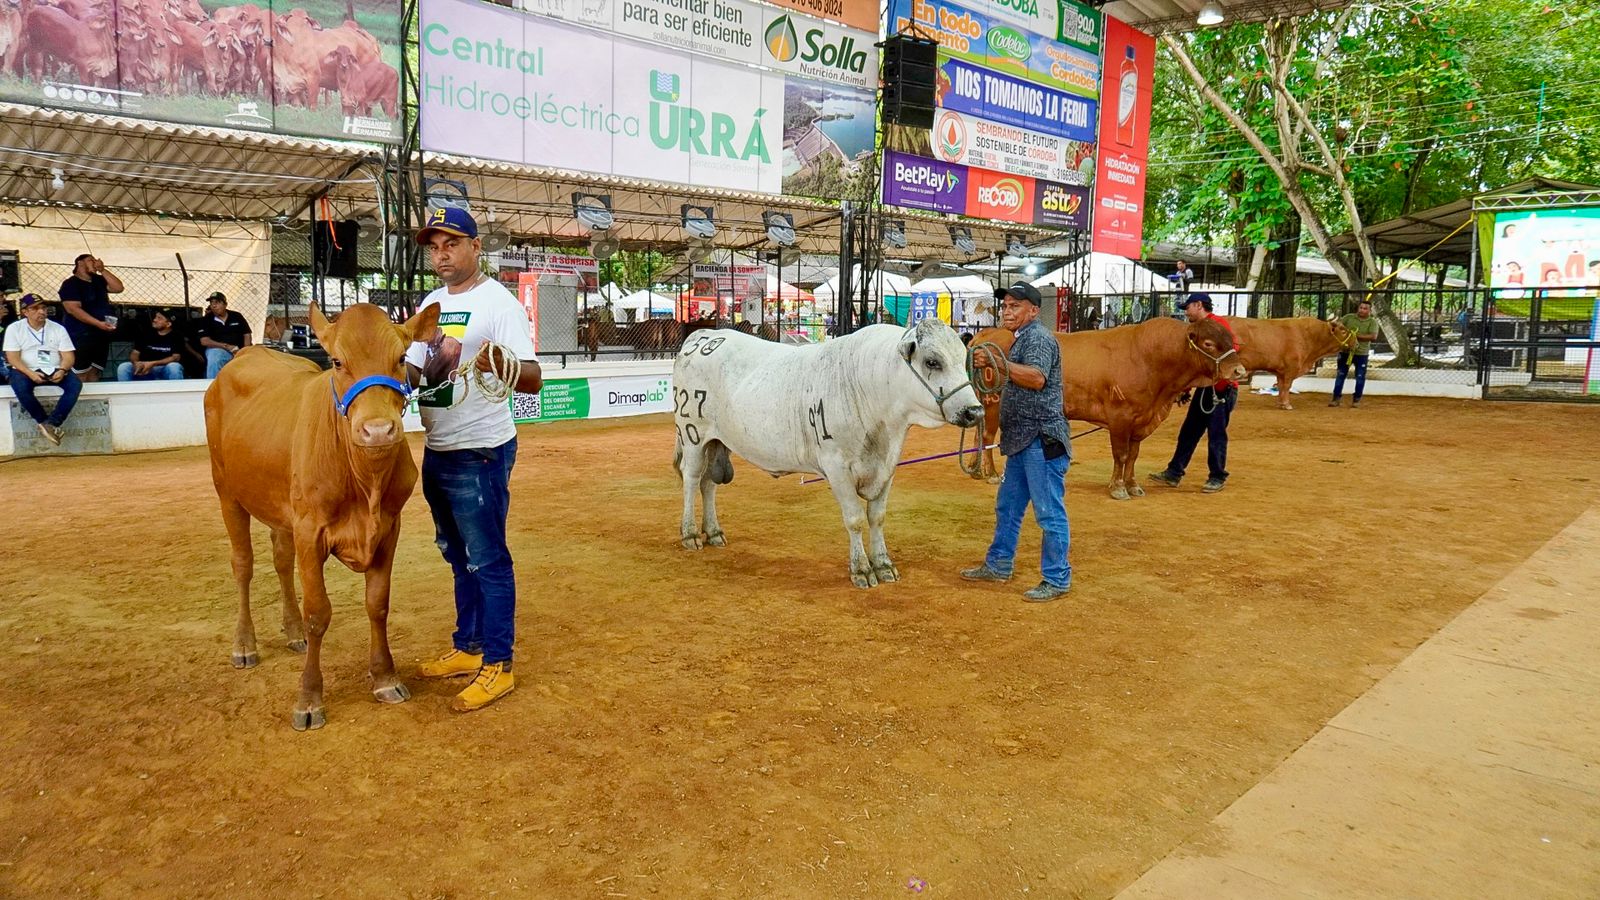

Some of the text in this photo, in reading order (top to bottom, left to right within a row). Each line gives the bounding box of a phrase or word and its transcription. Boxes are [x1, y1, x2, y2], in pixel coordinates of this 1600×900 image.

[713, 0, 742, 25] bien
[824, 0, 843, 17] 3024
[914, 0, 936, 26] En
[939, 6, 981, 39] todo
[623, 1, 752, 47] para ser eficiente
[423, 22, 544, 76] Central
[800, 28, 868, 74] Solla
[990, 29, 1027, 55] Codelac
[800, 62, 867, 87] Nutrición Animal
[1050, 61, 1097, 91] Cordobés
[425, 72, 641, 138] Hidroeléctrica
[955, 66, 981, 101] NOS
[985, 75, 1043, 117] TOMAMOS
[1045, 93, 1058, 120] LA
[1060, 97, 1088, 128] FERIA
[649, 101, 772, 164] URRÁ
[976, 121, 1023, 142] SEMBRANDO
[1023, 132, 1031, 144] EL
[1033, 133, 1059, 150] FUTURO
[975, 136, 1017, 155] SOSTENIBLE
[1018, 146, 1027, 157] DE
[895, 162, 946, 192] BetPlay
[1104, 156, 1140, 175] HIDRATACIÓN
[1107, 170, 1136, 186] INMEDIATA
[559, 255, 595, 267] SONRISA
[695, 265, 728, 273] HACIENDA
[608, 388, 664, 406] Dimaplab
